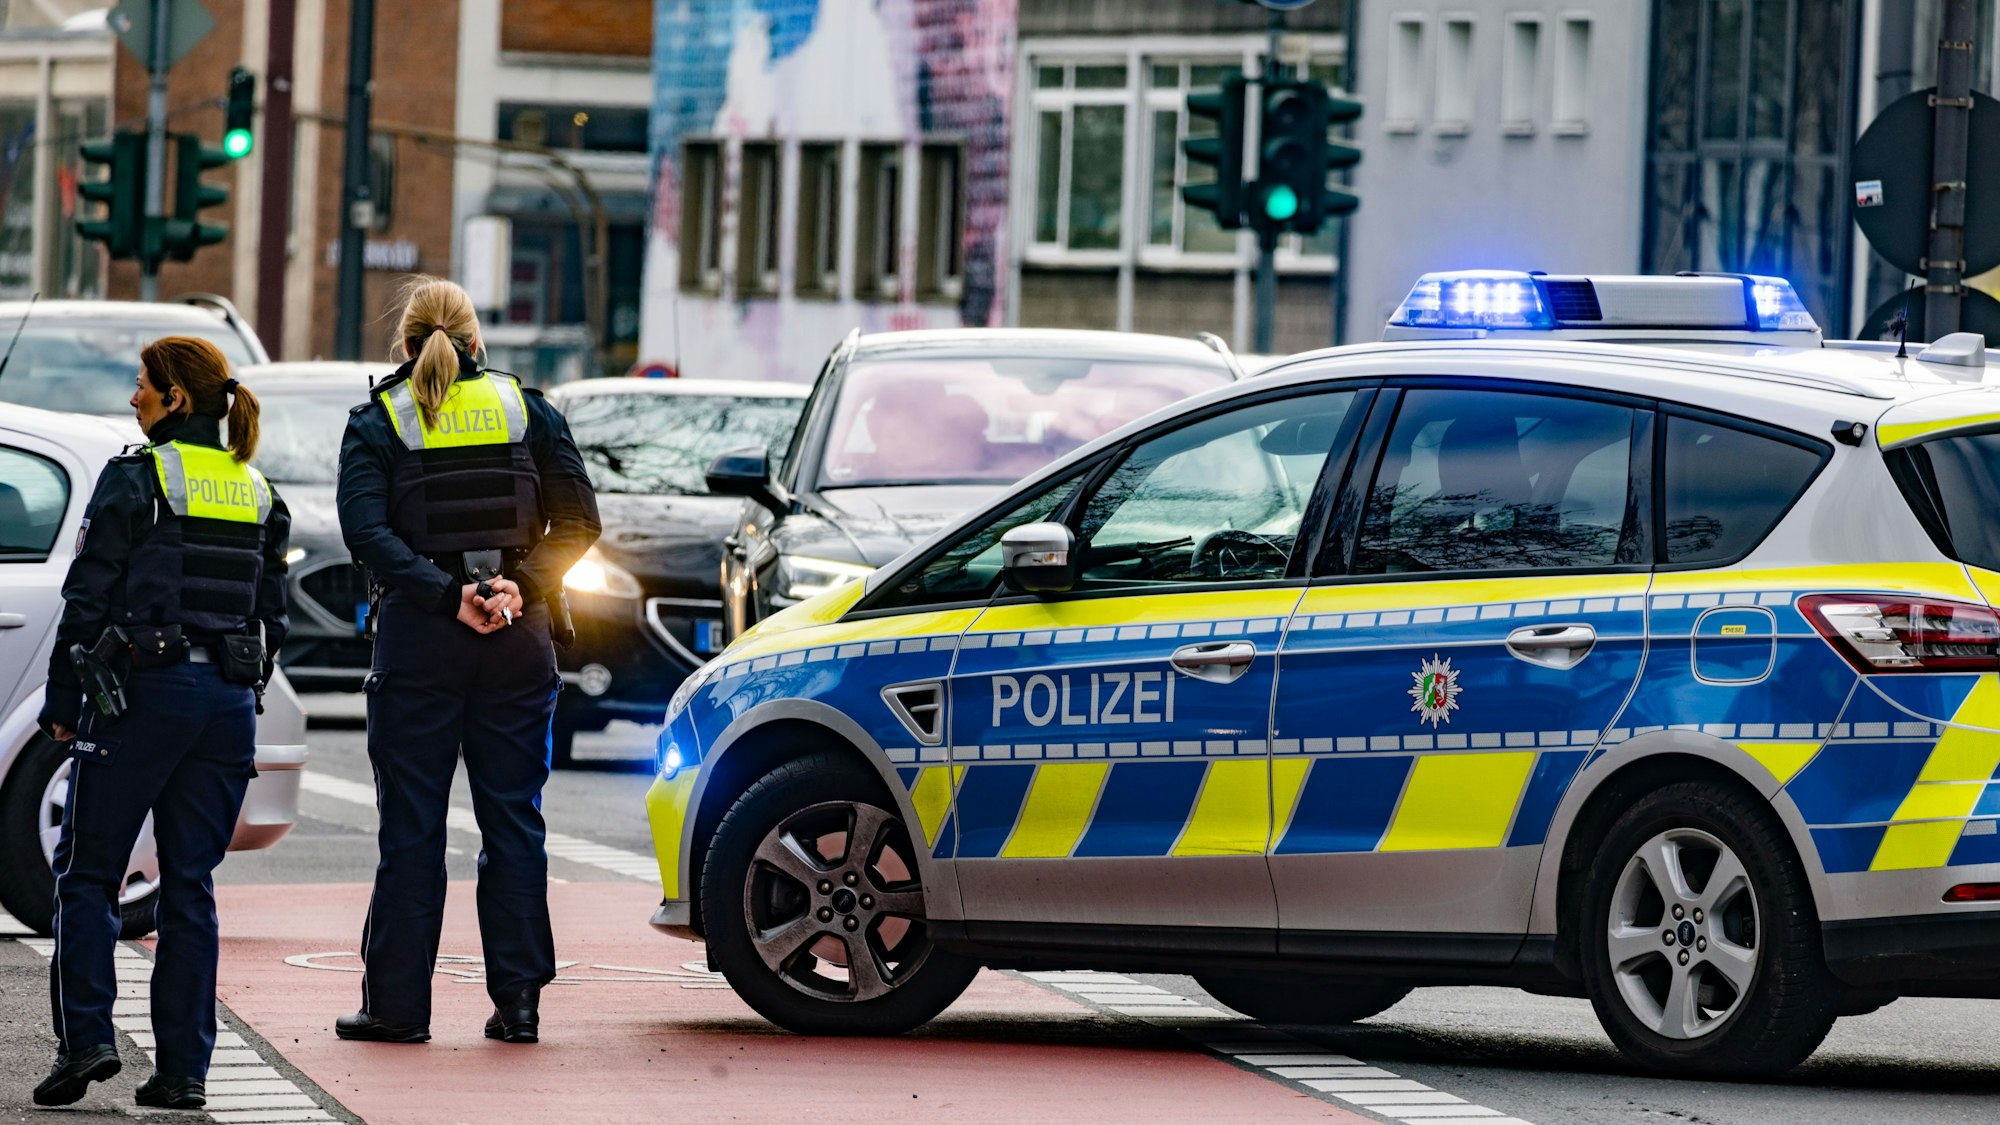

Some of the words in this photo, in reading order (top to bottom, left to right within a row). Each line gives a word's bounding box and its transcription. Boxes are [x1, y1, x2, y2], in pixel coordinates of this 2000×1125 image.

[427, 408, 502, 436] OLIZEI
[188, 478, 255, 508] POLIZEI
[992, 671, 1176, 728] POLIZEI
[75, 741, 96, 752] POLIZEI
